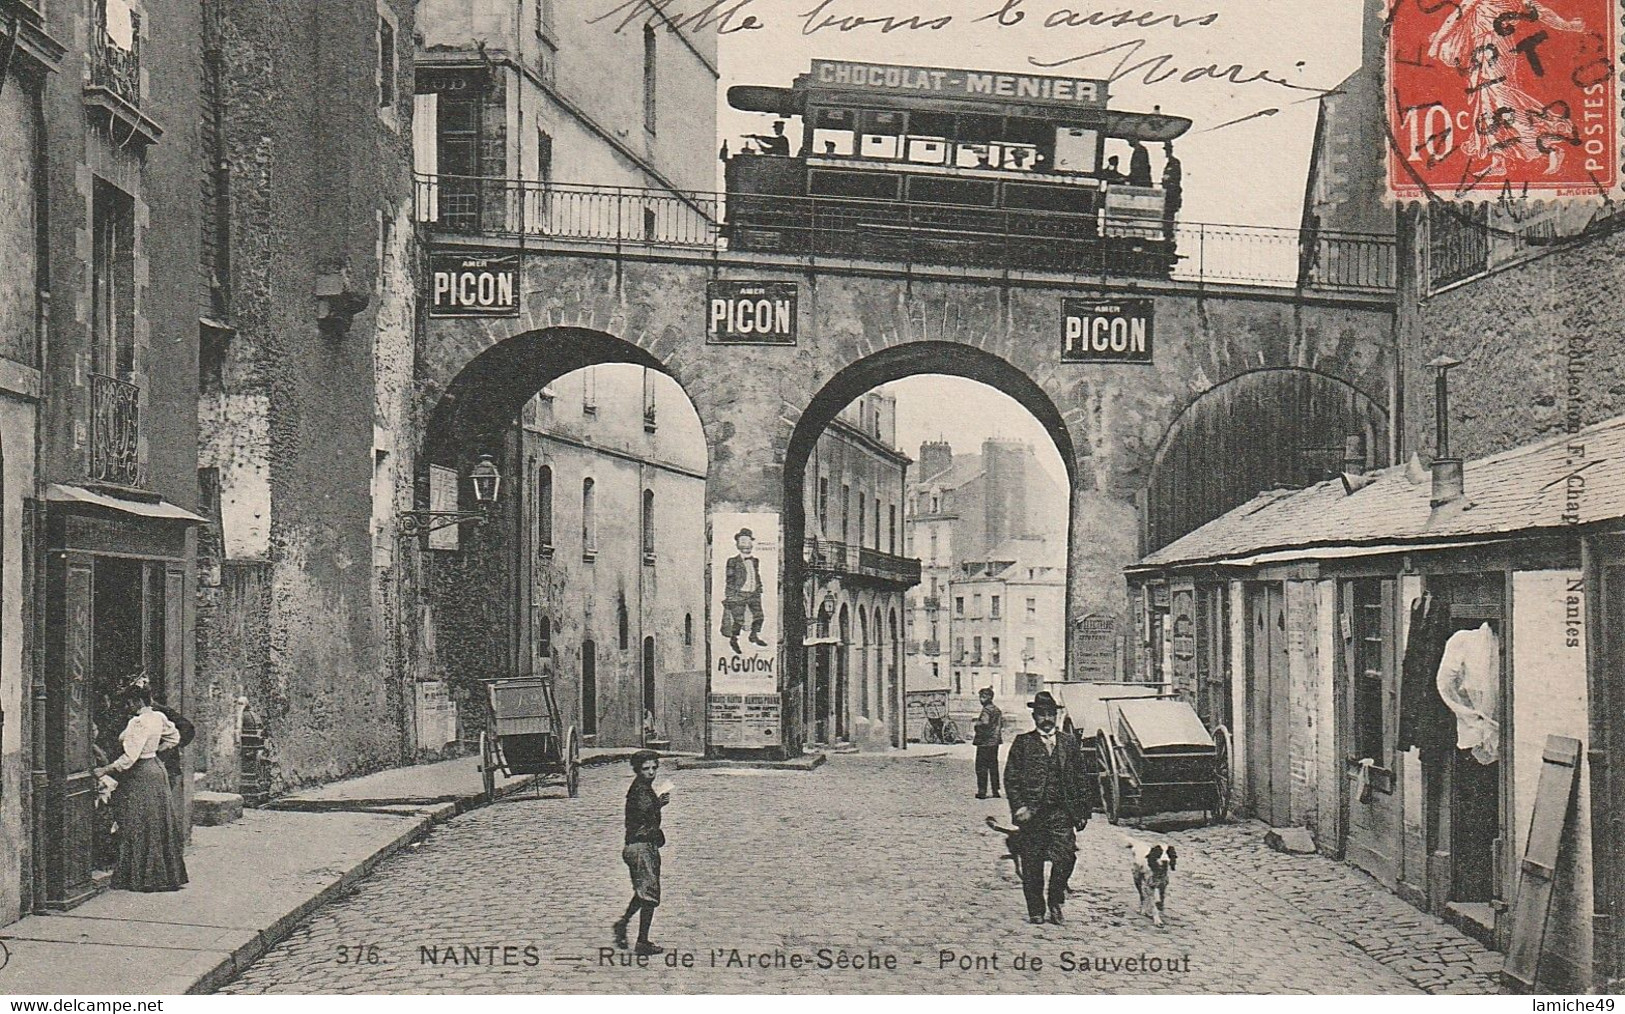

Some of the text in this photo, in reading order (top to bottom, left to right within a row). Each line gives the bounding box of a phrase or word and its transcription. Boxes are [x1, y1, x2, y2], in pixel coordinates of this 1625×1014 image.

[1584, 83, 1605, 171] POSTES
[434, 272, 513, 306] PICON
[711, 299, 790, 334] PICON
[1066, 316, 1146, 352] PICON
